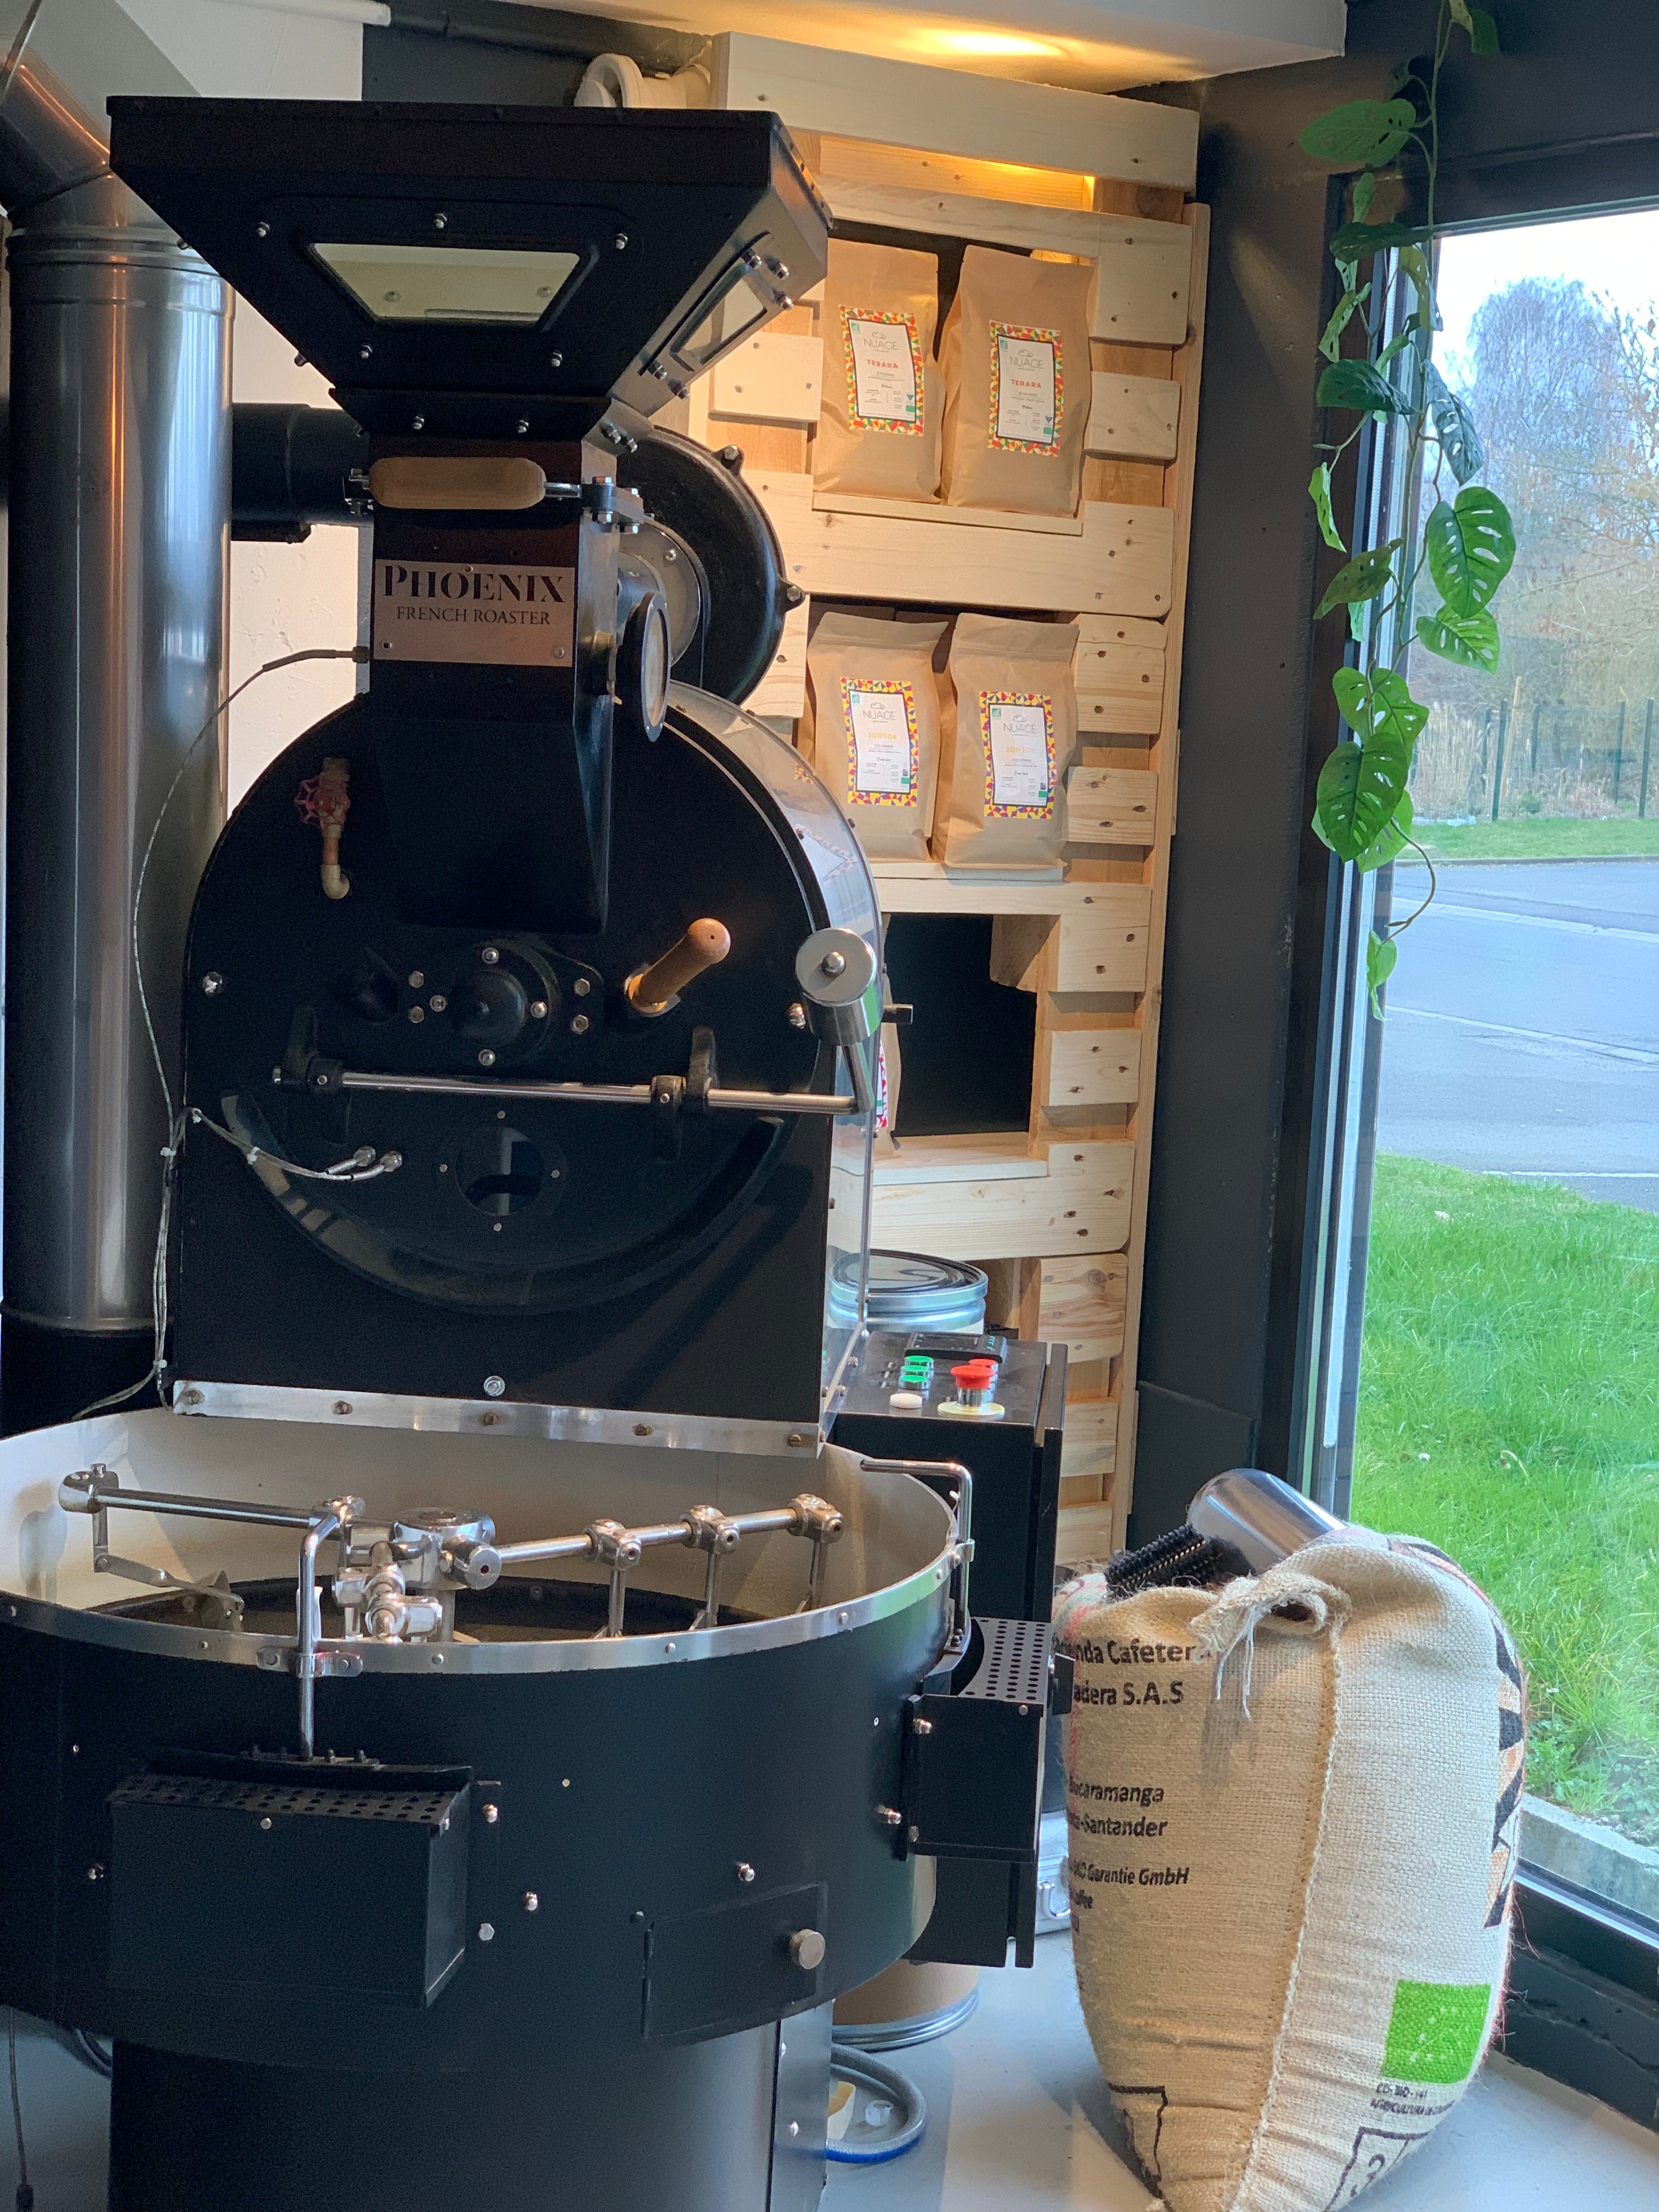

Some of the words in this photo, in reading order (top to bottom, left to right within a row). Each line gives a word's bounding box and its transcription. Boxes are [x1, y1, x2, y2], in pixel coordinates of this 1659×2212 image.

[863, 337, 900, 351] NUAGE
[867, 359, 899, 369] TERARA
[1010, 356, 1044, 369] NUAGE
[1011, 379, 1042, 389] TERARA
[383, 565, 566, 603] PHOENIX
[397, 606, 467, 622] FRENCH
[474, 609, 550, 625] ROASTER
[862, 709, 897, 721] NUAGE
[1003, 723, 1036, 735] NUAGE
[1073, 1680, 1117, 1705] adera
[1122, 1680, 1184, 1706] S.A.S
[1088, 1863, 1136, 1884] Garantie
[1138, 1867, 1189, 1886] GmbH
